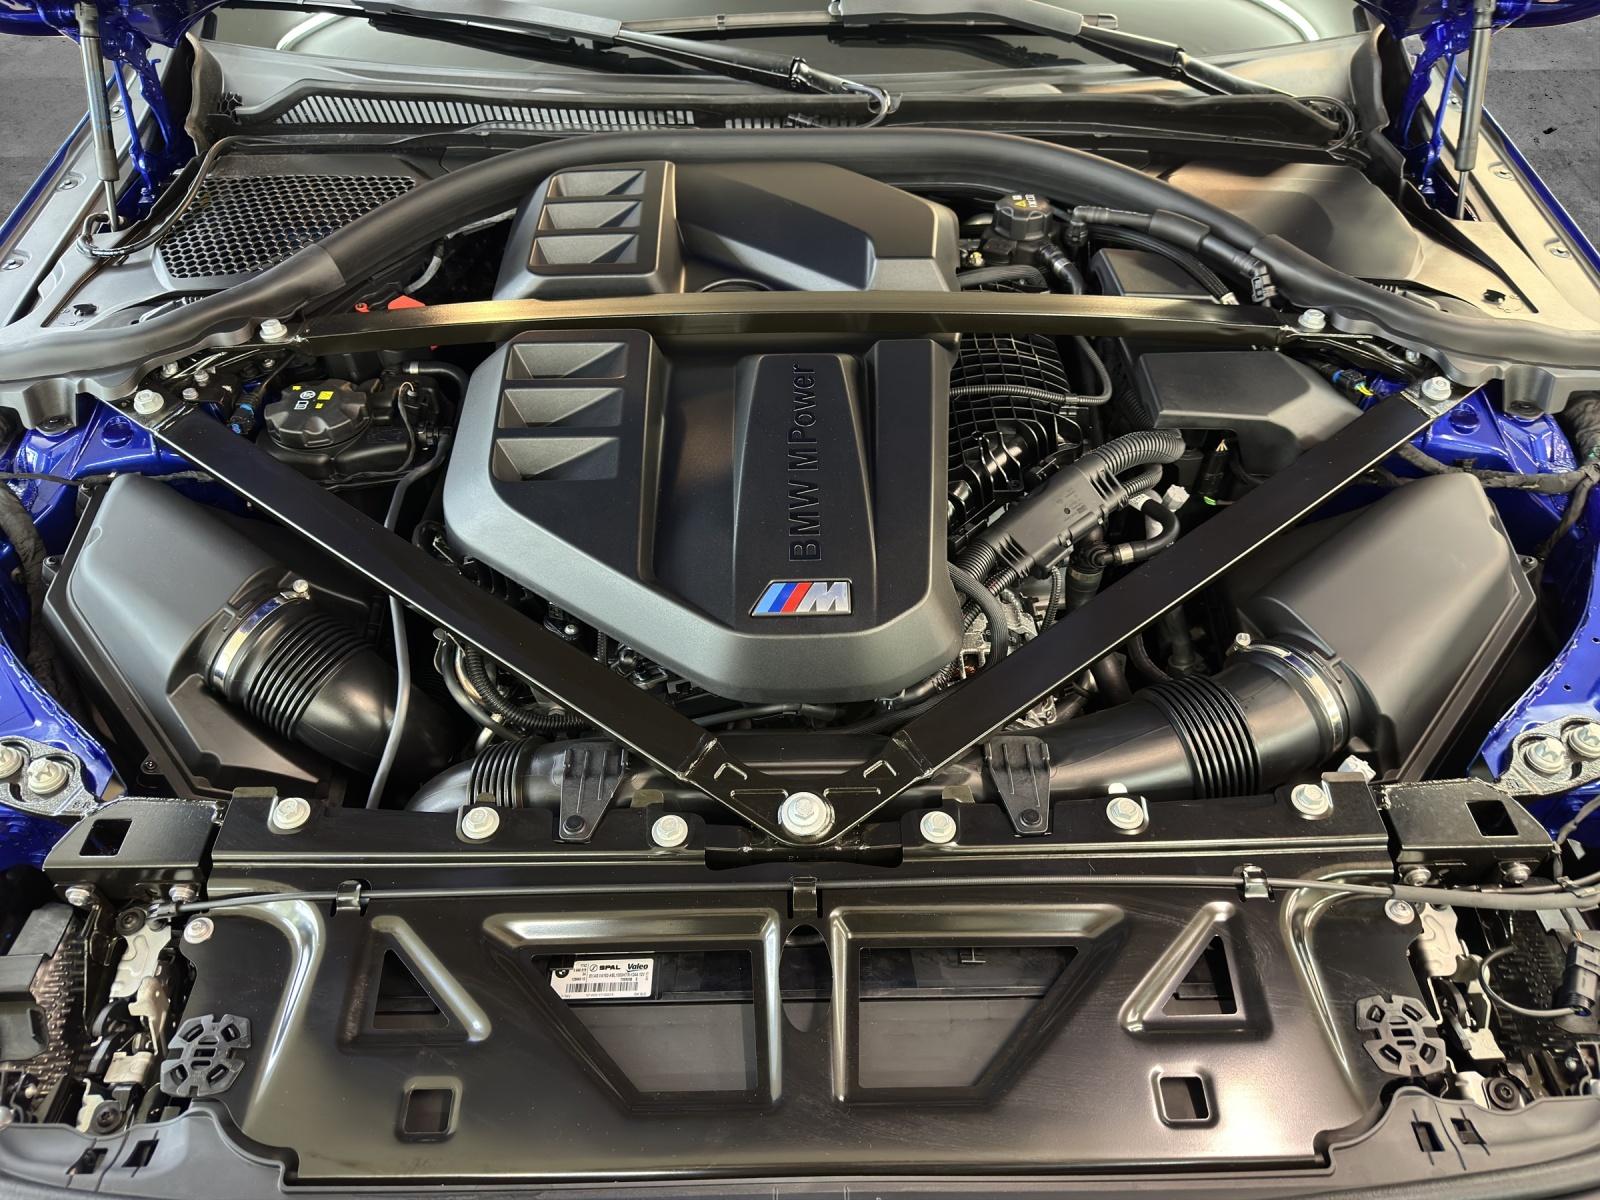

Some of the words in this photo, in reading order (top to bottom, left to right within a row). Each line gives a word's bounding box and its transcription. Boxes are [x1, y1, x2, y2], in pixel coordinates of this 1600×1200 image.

[787, 363, 819, 472] MPower
[788, 479, 822, 562] BMW
[795, 582, 848, 612] M
